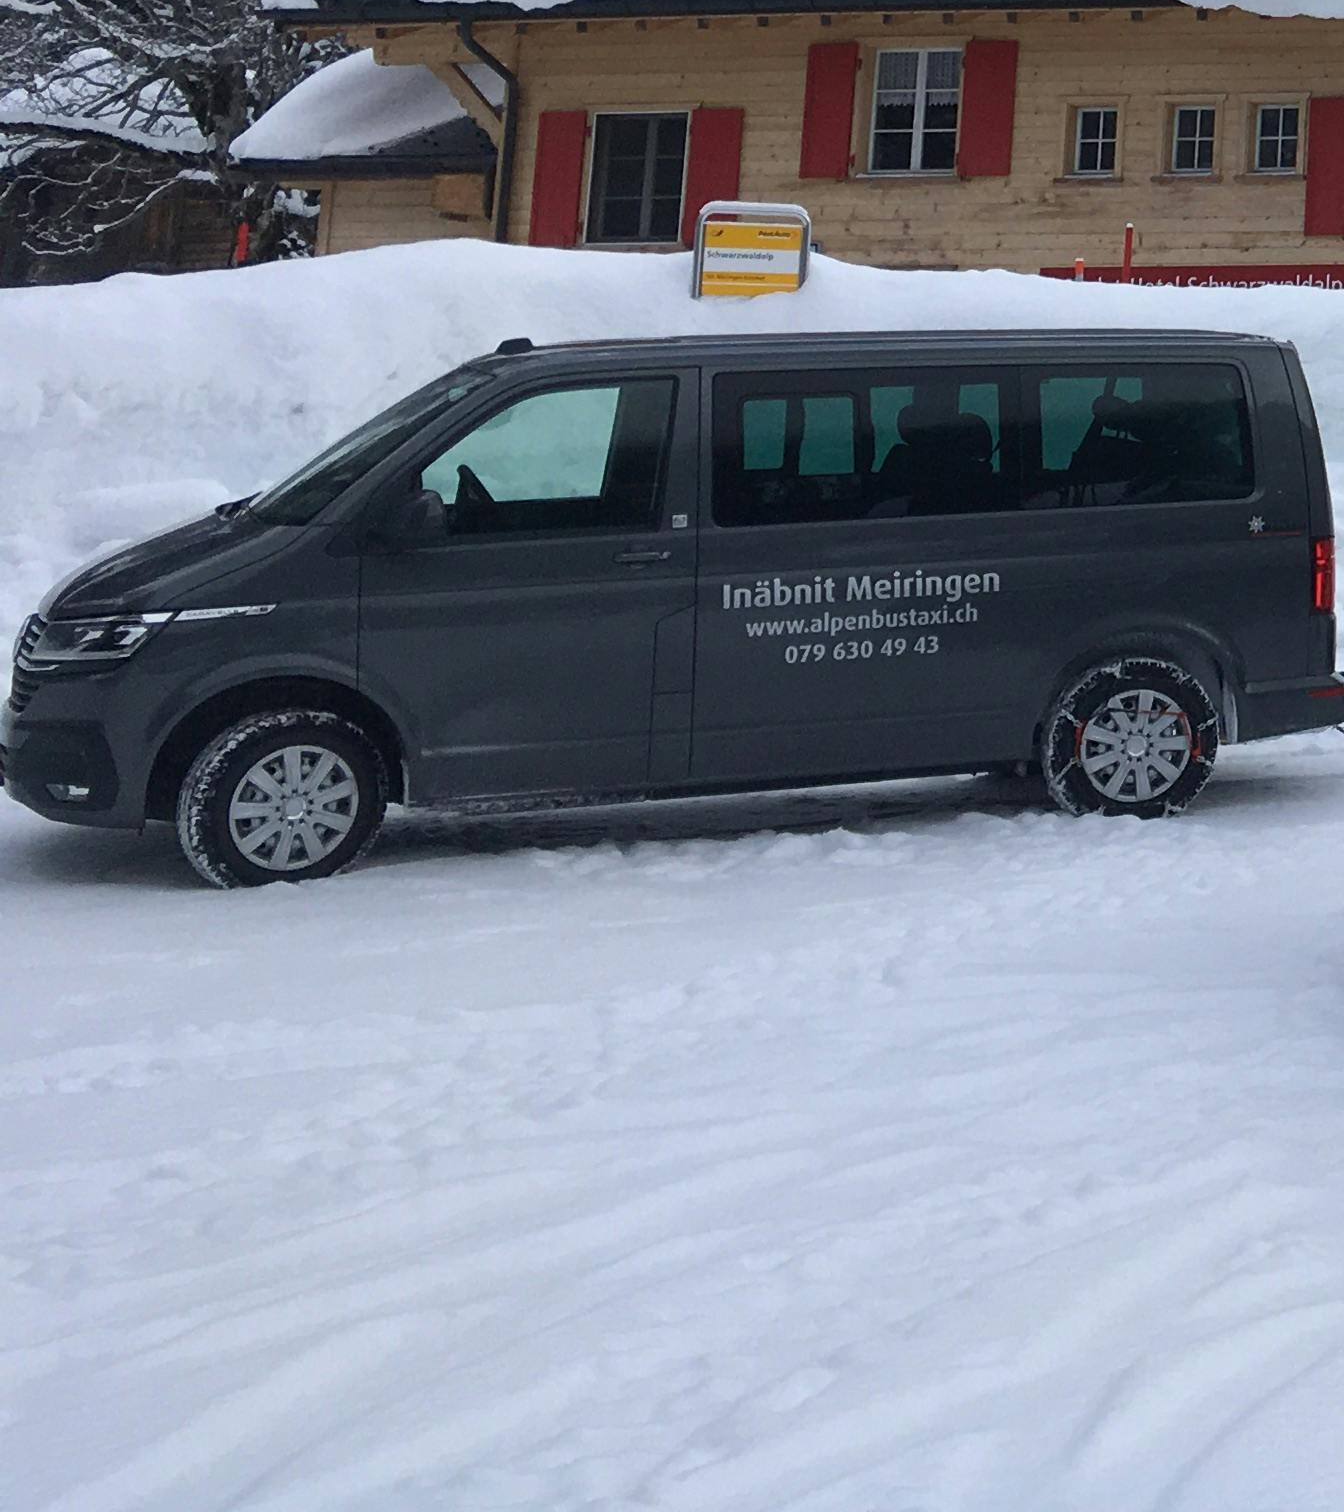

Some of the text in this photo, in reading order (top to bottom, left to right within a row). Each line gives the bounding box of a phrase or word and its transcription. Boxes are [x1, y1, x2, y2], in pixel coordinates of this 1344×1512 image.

[707, 250, 774, 261] Schwarzwaldalp
[723, 570, 1000, 609] Inäbnit Meiringen
[746, 603, 978, 637] www.alpenbustaxi.ch
[785, 636, 939, 664] 079 630 49 43
